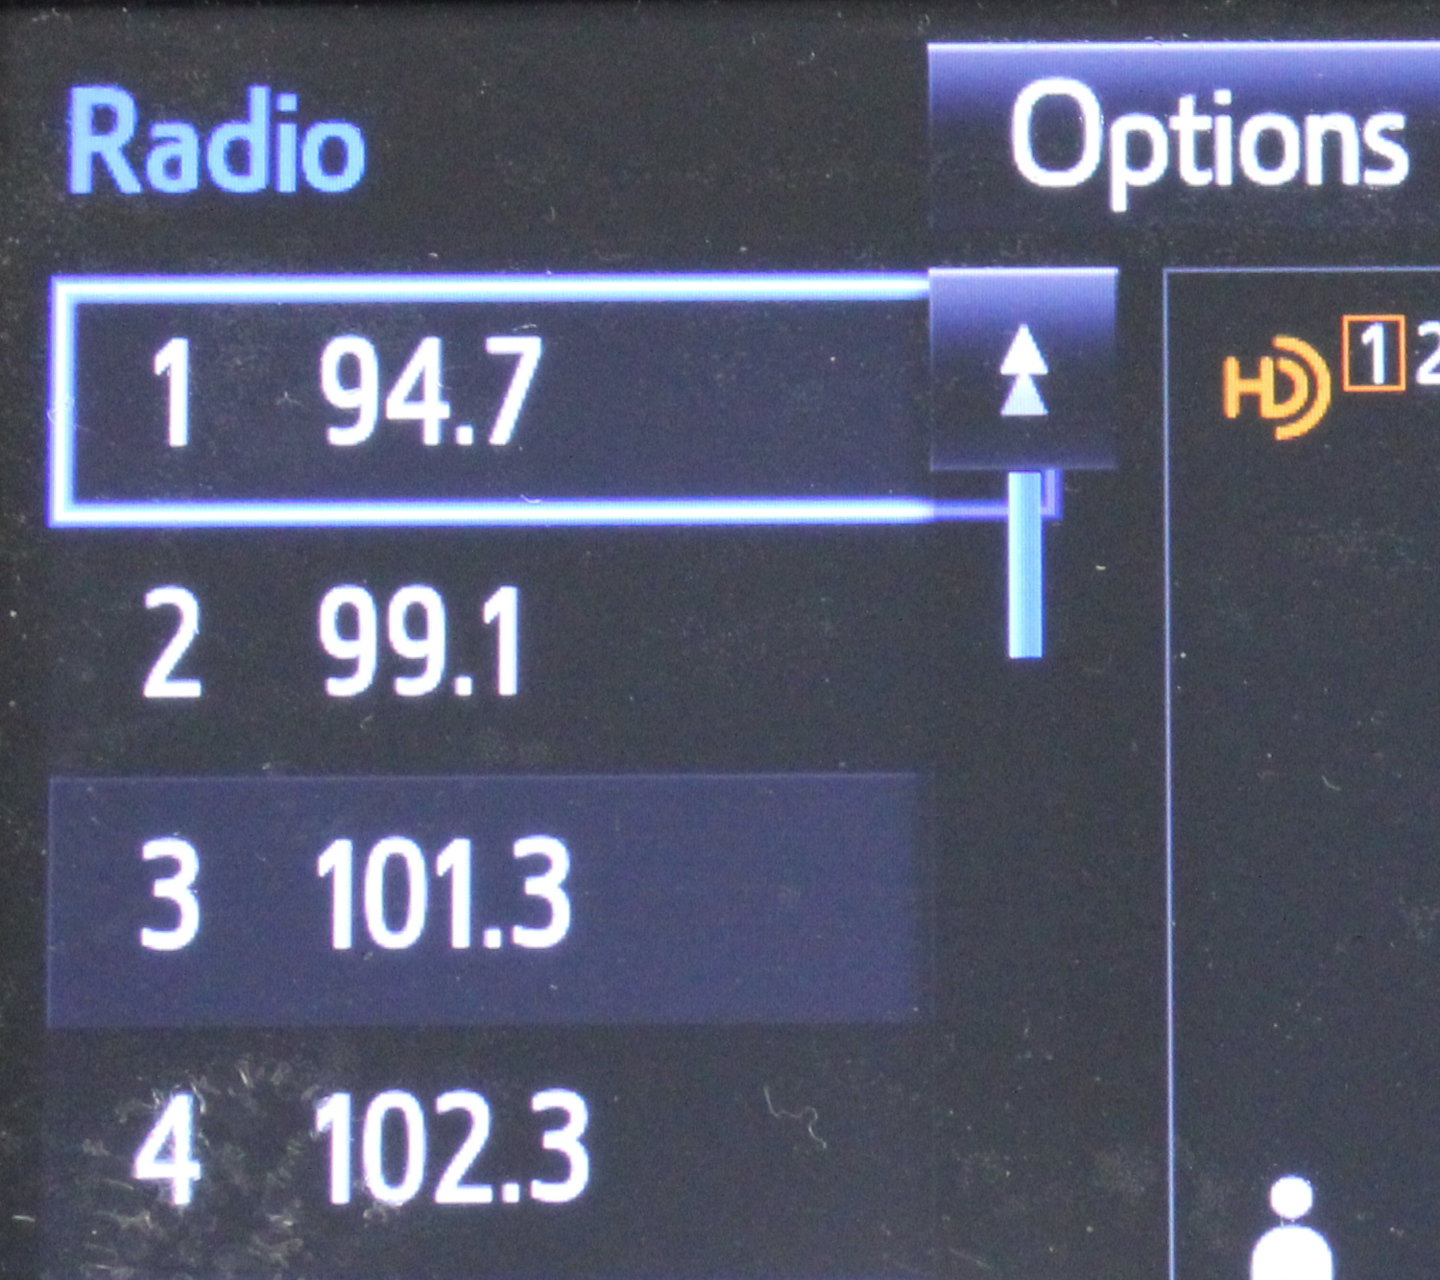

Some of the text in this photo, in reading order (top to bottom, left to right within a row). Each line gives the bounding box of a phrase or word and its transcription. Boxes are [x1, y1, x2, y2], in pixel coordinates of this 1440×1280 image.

[65, 82, 368, 196] Radio
[1010, 74, 1411, 214] Options
[153, 333, 543, 448] 1 94.7
[142, 583, 519, 699] 2 99.1
[140, 834, 572, 952] 3 101.3
[134, 1088, 590, 1207] 4 102.3
